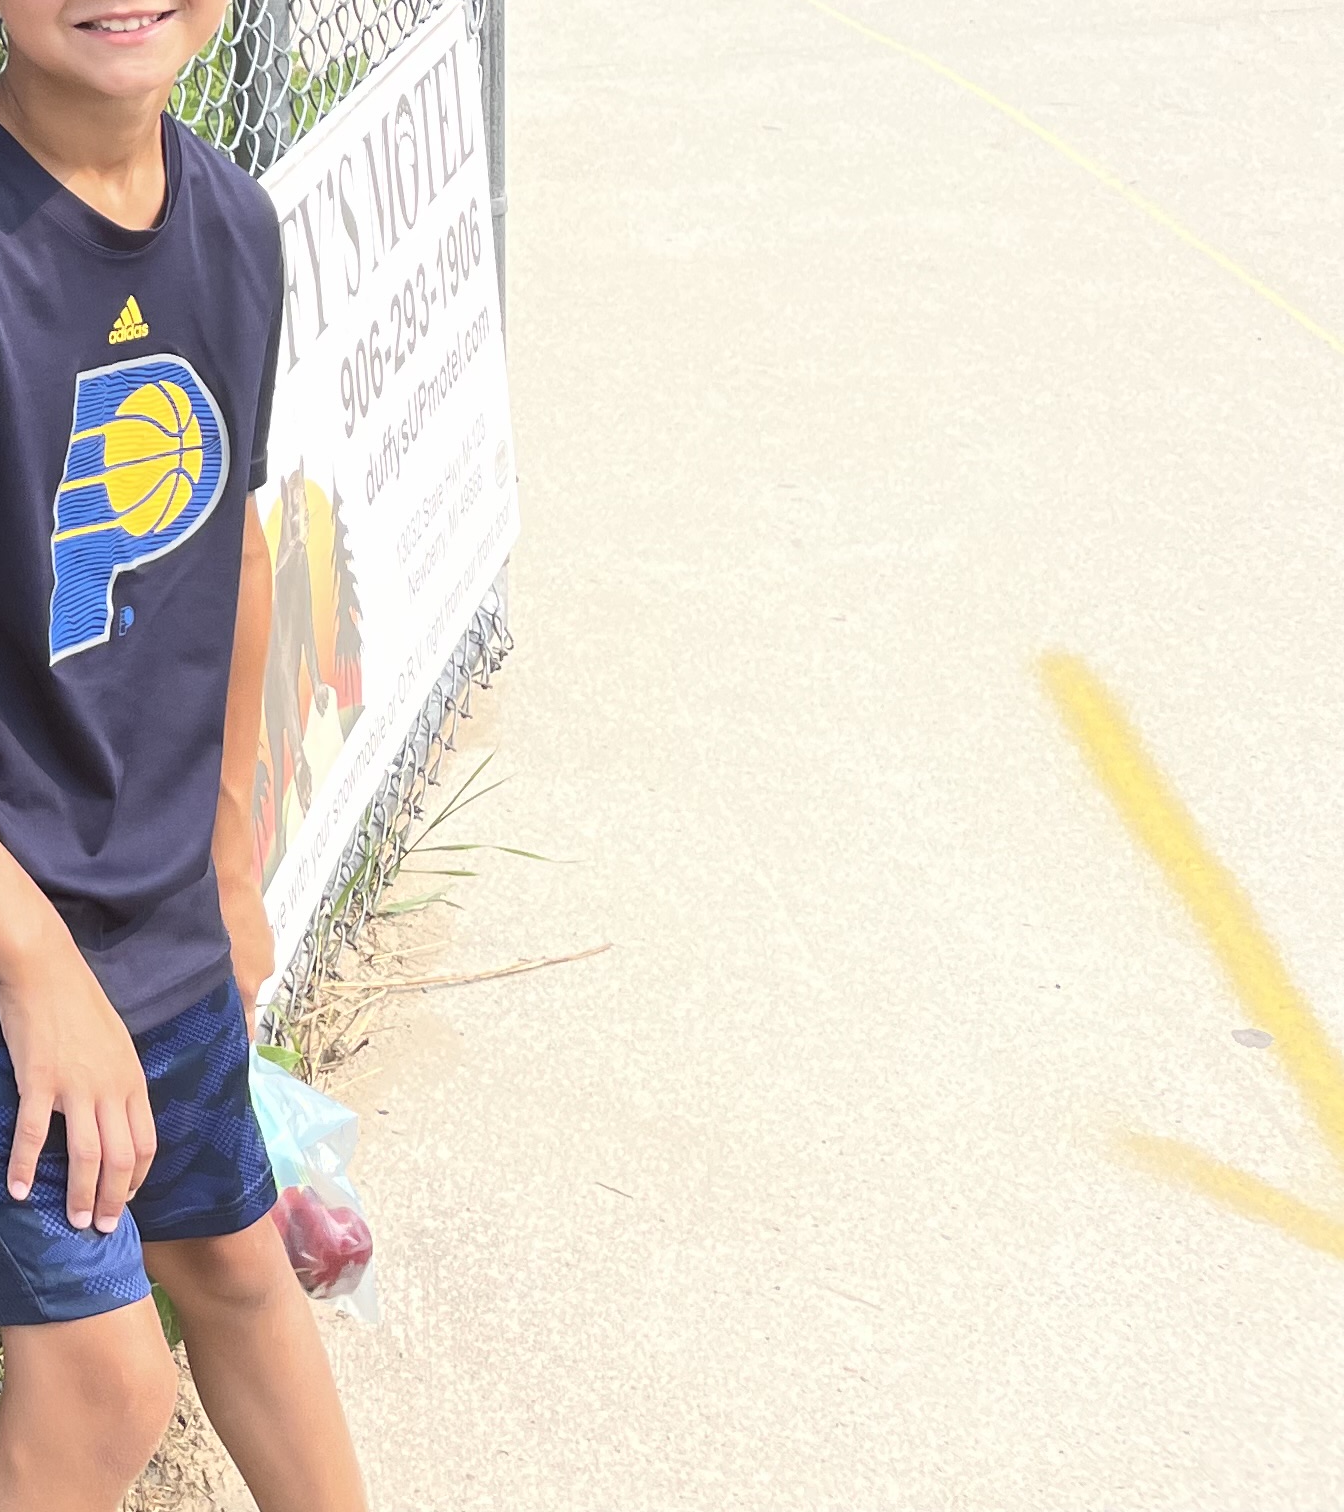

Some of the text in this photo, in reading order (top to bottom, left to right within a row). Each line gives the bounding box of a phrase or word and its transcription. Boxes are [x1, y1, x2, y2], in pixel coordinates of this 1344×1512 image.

[363, 40, 474, 272] MOTEL
[109, 323, 149, 345] adidas
[341, 197, 481, 438] 906-293-1906
[366, 307, 490, 506] duffysUPmotel.com
[422, 483, 444, 528] State
[444, 455, 461, 496] Hwy
[461, 412, 486, 467] M-123
[287, 856, 310, 911] with
[310, 810, 331, 878] your
[332, 715, 386, 825] snowmobile
[387, 693, 397, 727] or
[425, 605, 446, 656] right
[444, 578, 463, 623] from
[463, 554, 476, 592] our
[476, 523, 495, 569] front
